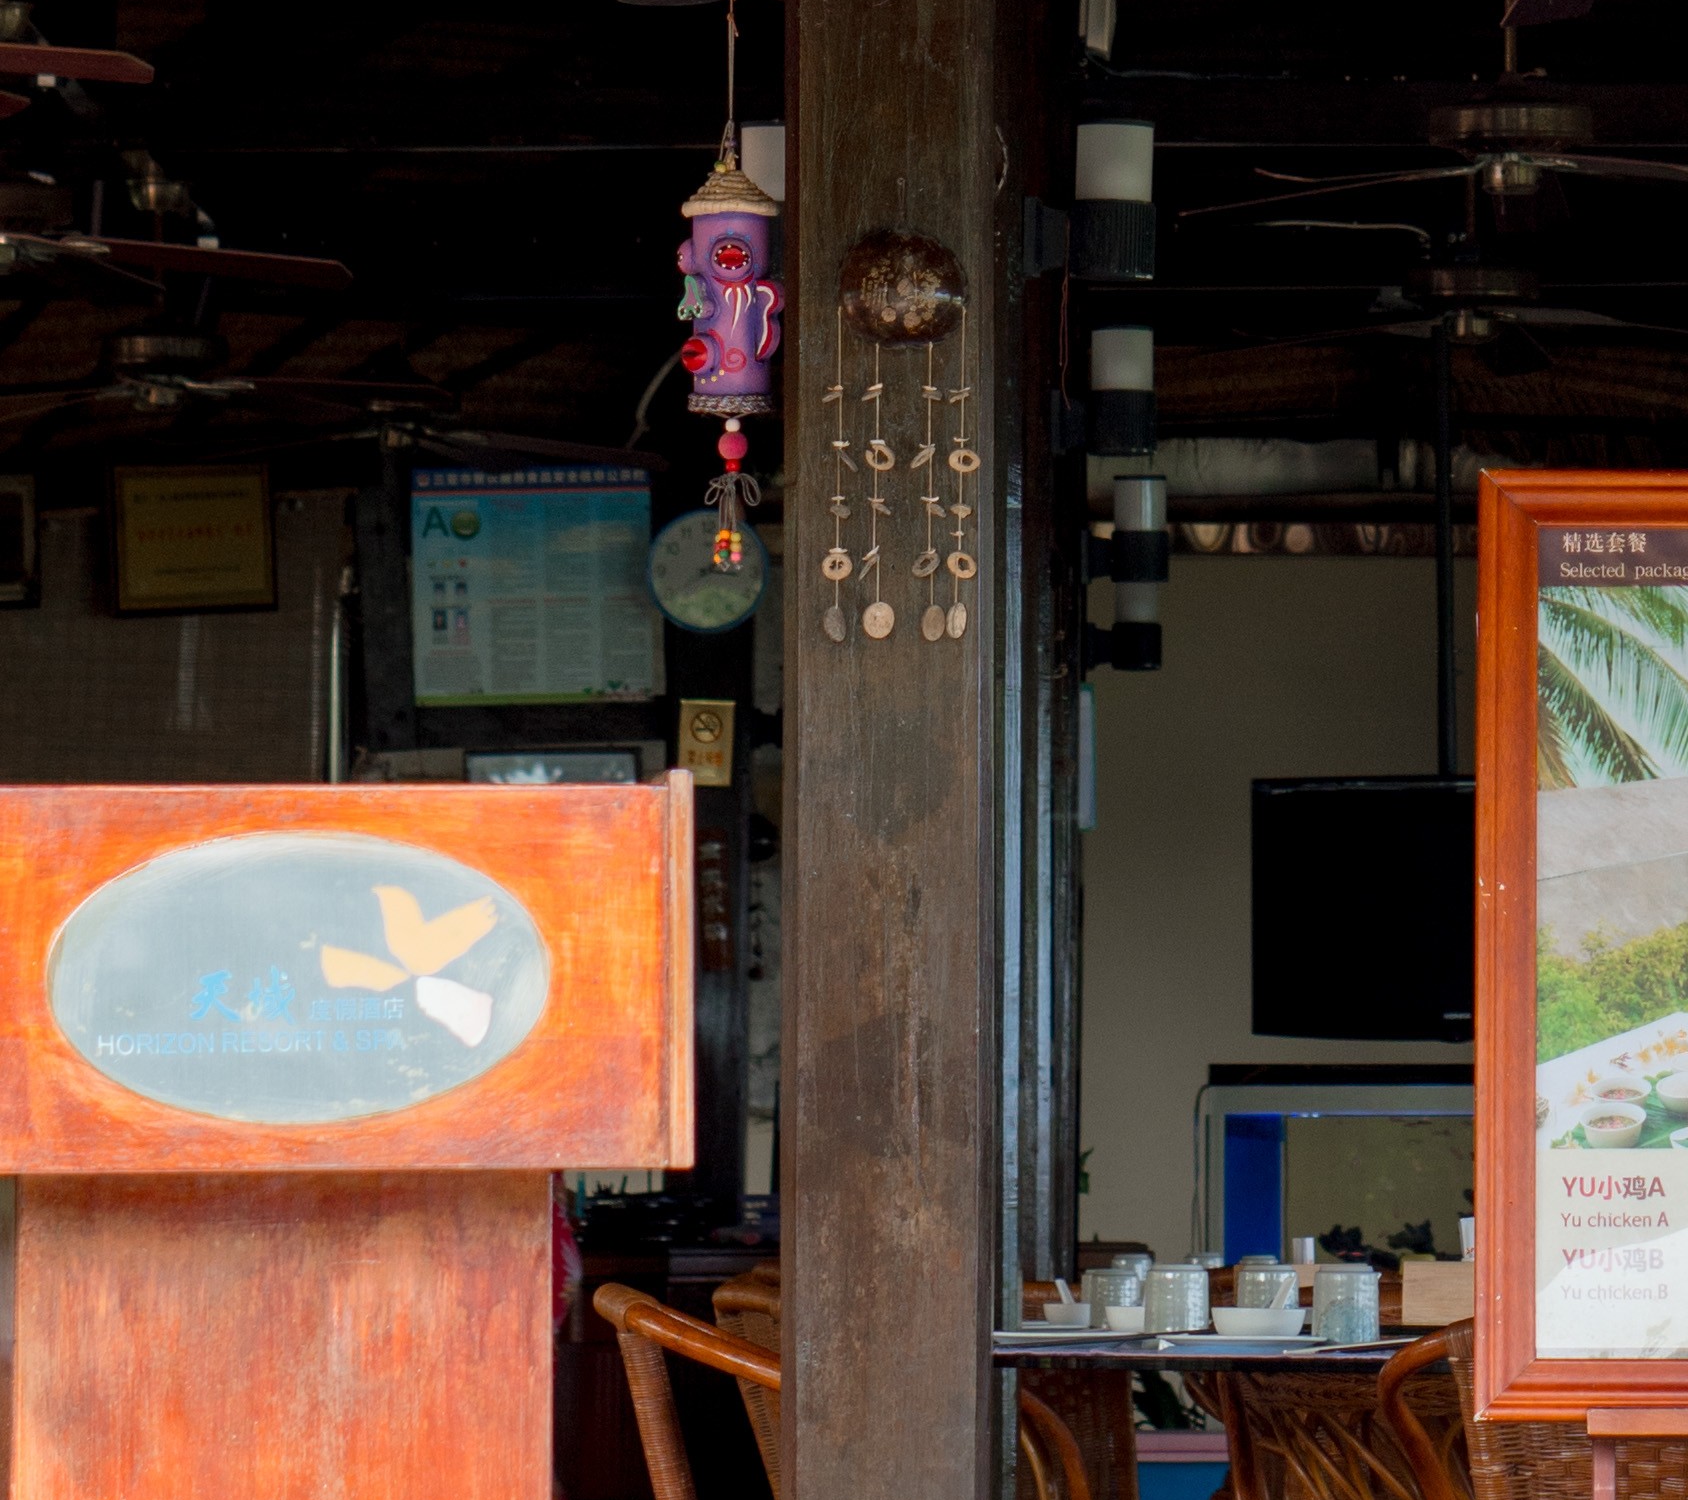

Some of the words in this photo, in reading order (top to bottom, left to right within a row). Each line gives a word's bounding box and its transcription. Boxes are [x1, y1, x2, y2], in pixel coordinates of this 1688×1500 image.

[1562, 532, 1648, 554] 精选套餐
[1560, 562, 1626, 578] Selected
[189, 965, 296, 1025] 天域
[309, 997, 405, 1020] 度假酒店
[97, 1032, 215, 1056] HORIZON
[222, 1030, 324, 1053] RESORT
[331, 1029, 349, 1051] &
[1562, 1175, 1666, 1200] YU小鸡A
[1561, 1212, 1582, 1228] Yu
[1587, 1212, 1652, 1228] chicken
[1656, 1212, 1670, 1228] A
[1562, 1247, 1665, 1273] YU小鸡B
[1561, 1285, 1582, 1301] Yu
[1587, 1284, 1652, 1301] chicken
[1657, 1284, 1669, 1300] B
